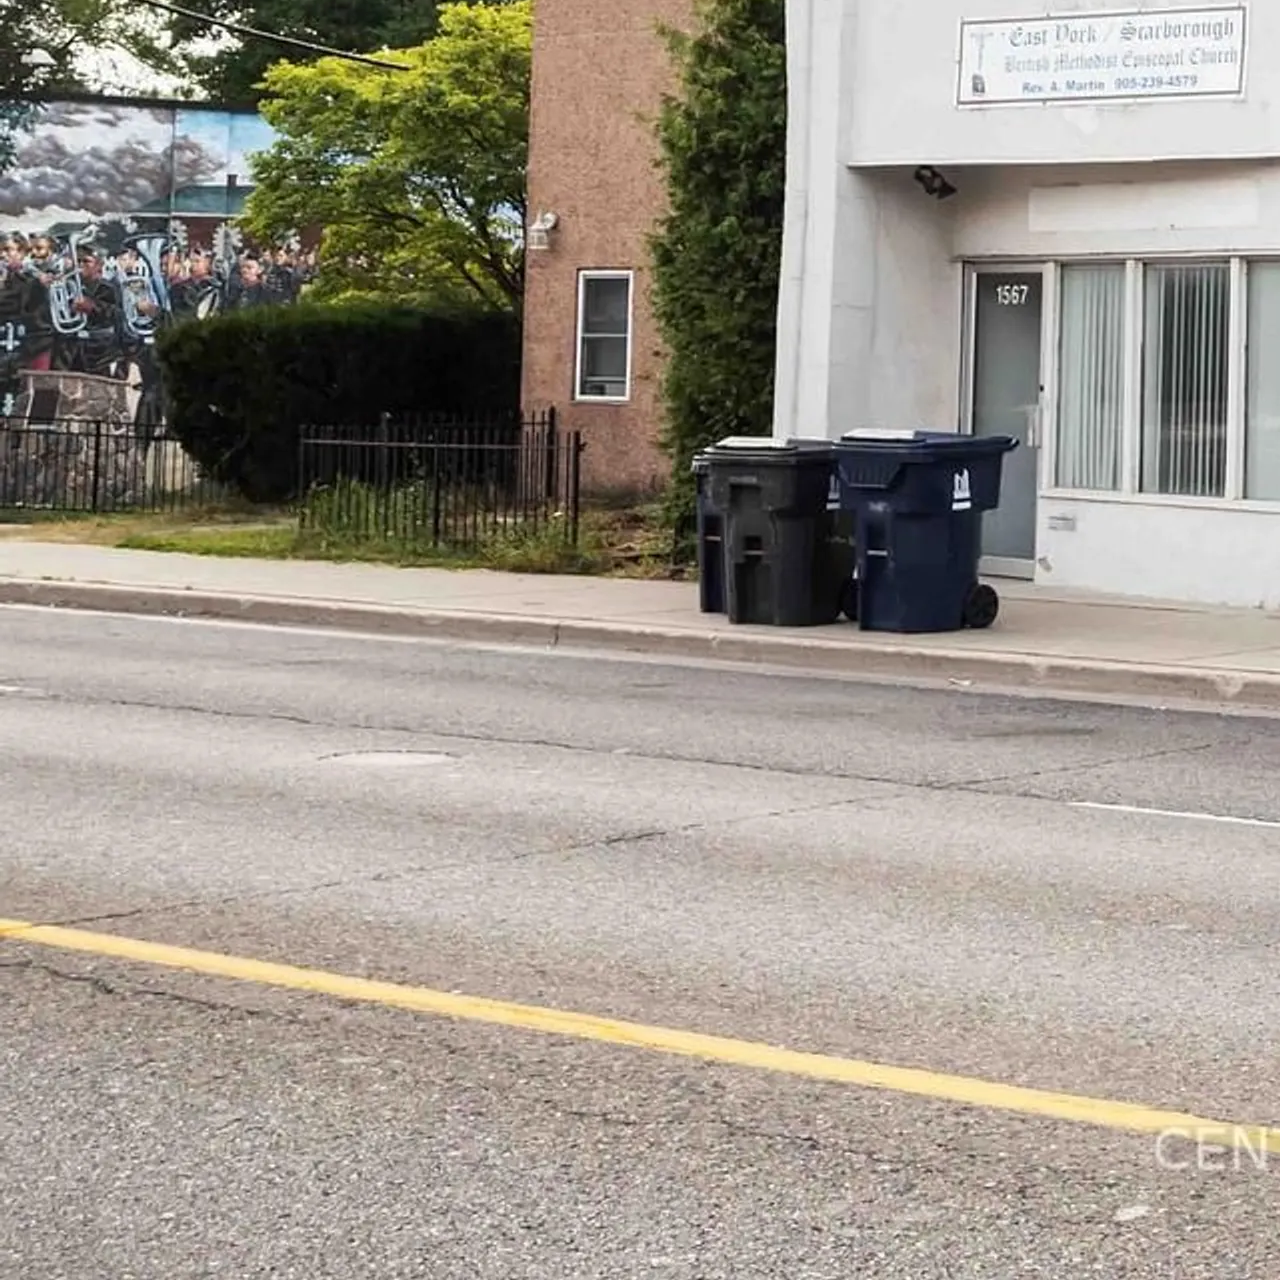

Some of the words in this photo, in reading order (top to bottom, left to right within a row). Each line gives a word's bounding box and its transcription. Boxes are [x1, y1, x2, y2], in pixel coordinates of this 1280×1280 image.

[1009, 27, 1048, 48] East
[1055, 23, 1098, 47] York
[1119, 17, 1235, 41] Scarborough
[1189, 46, 1239, 66] Church
[1065, 78, 1105, 92] Martin
[996, 285, 1029, 305] 1567
